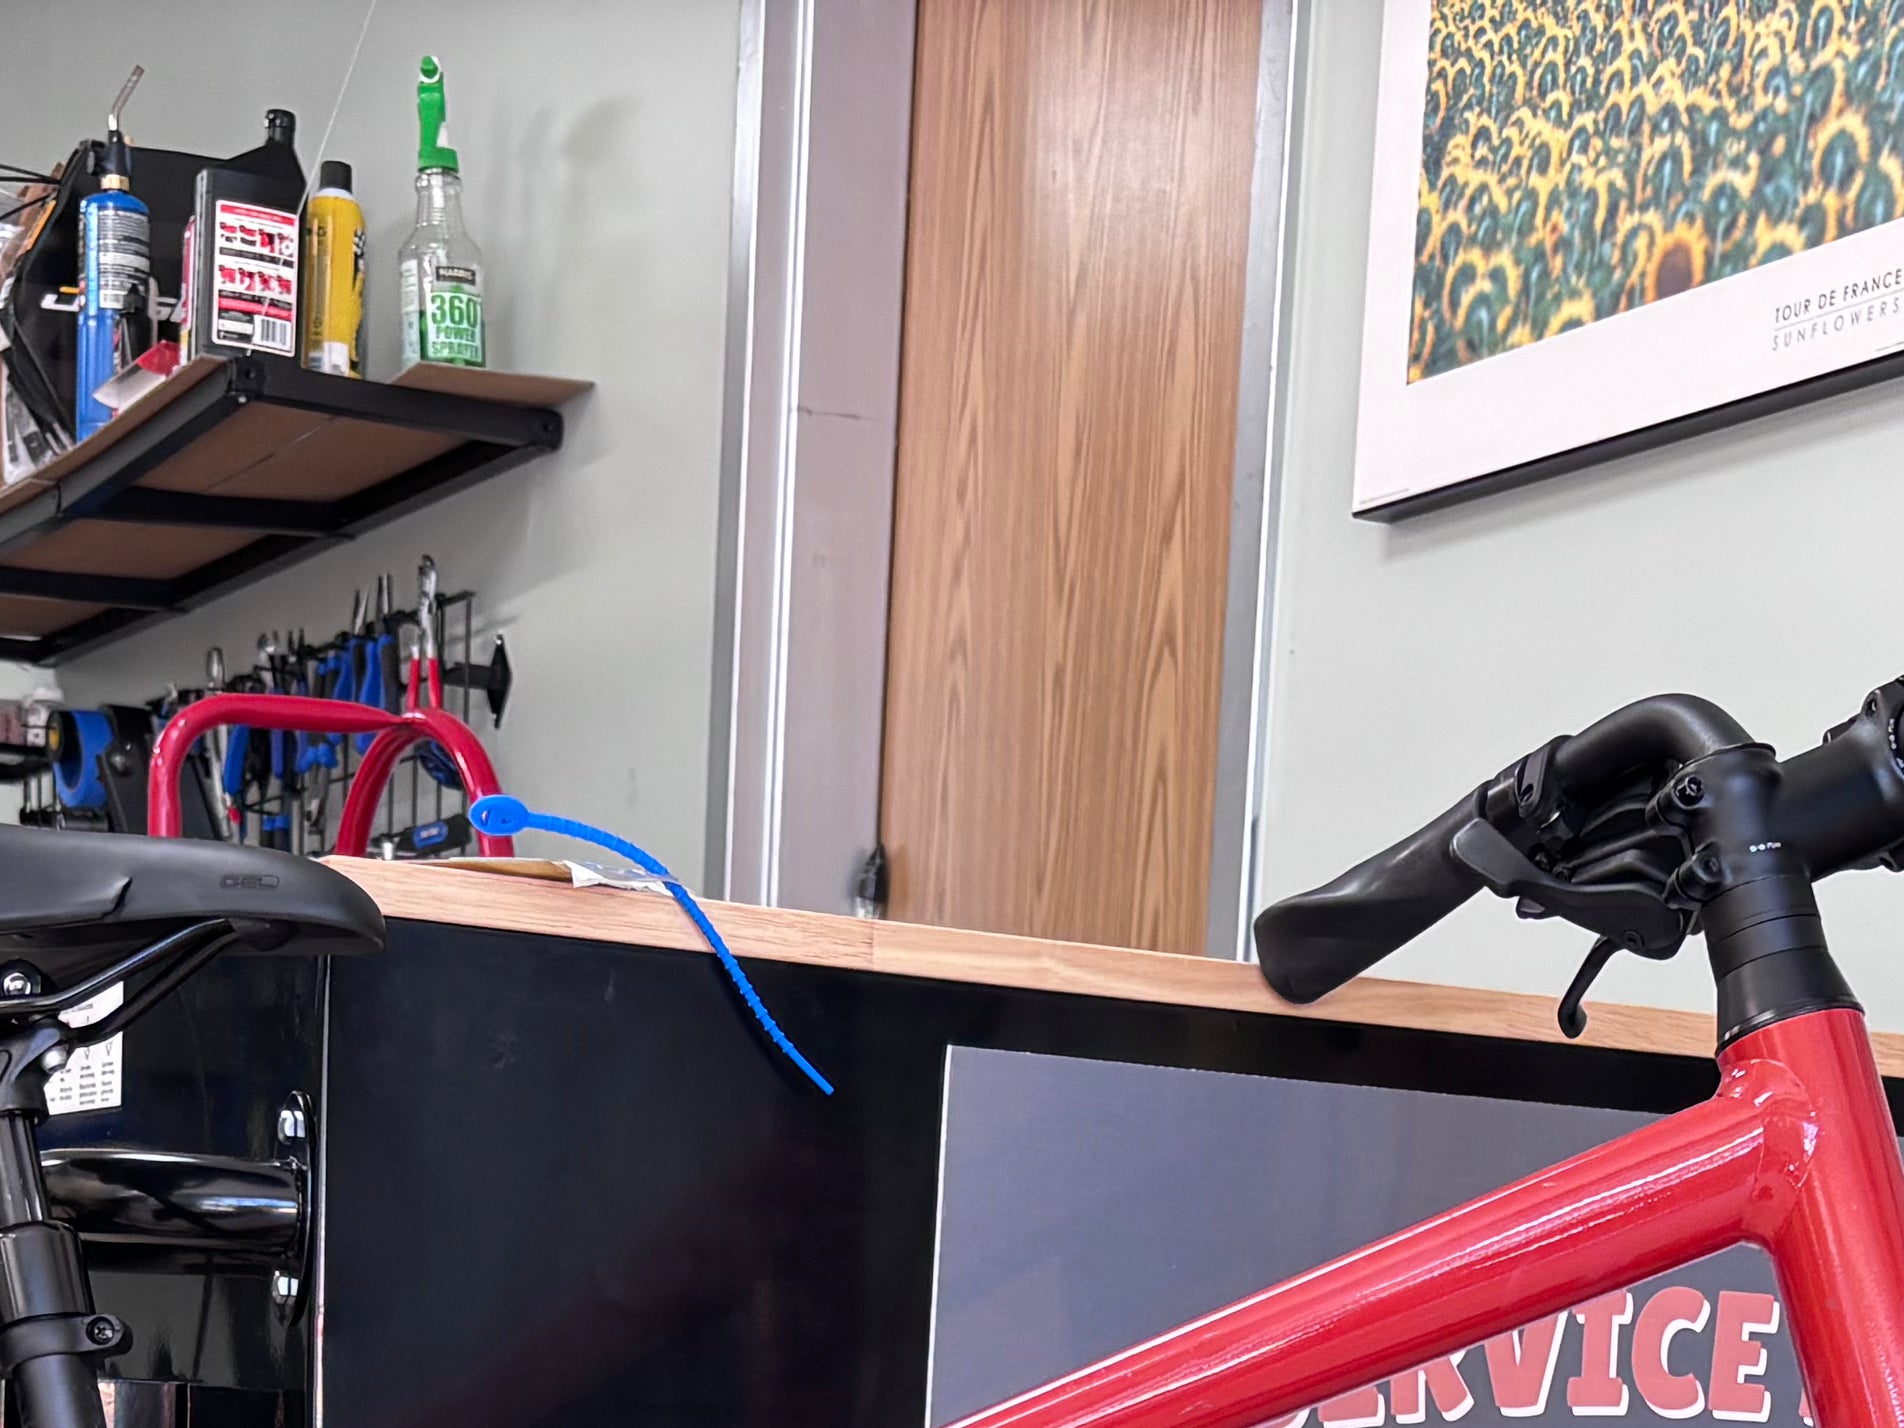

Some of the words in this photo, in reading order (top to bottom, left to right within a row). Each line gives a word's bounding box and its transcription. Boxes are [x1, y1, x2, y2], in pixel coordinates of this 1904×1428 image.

[430, 294, 477, 329] 360
[1775, 299, 1811, 323] TOUR
[1818, 290, 1836, 310] DE
[1843, 268, 1902, 301] FRANCE
[1772, 297, 1900, 351] SUNFLOWERS
